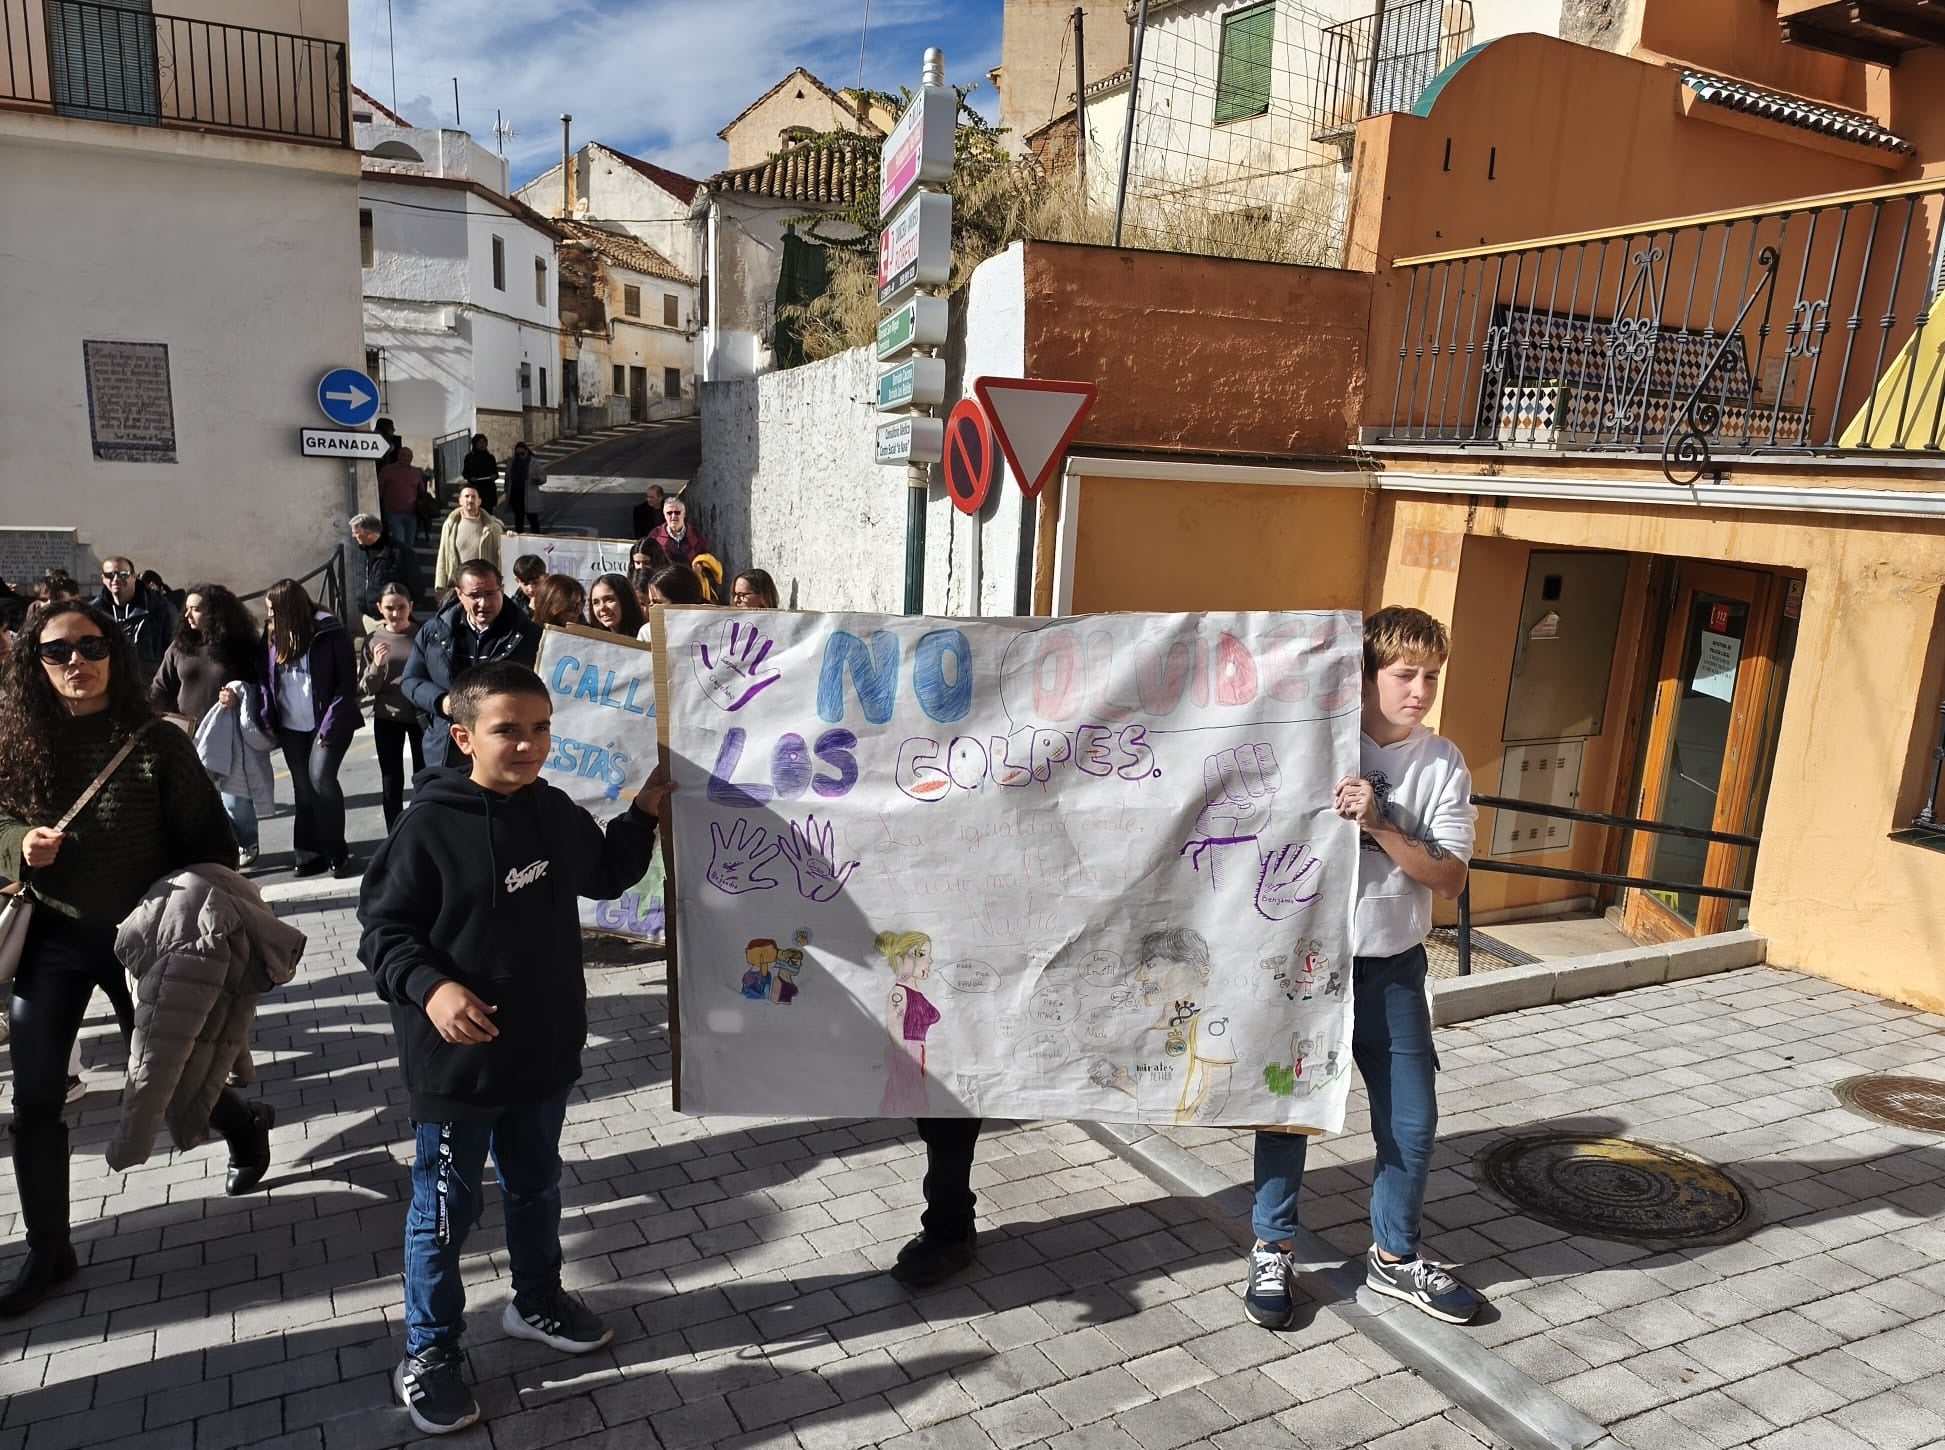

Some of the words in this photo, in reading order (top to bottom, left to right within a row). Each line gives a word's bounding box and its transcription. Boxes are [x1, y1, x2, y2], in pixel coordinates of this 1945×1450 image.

[305, 434, 380, 452] GRANADA
[1717, 611, 1727, 621] 112
[552, 655, 657, 718] CALL
[816, 628, 974, 725] NO
[706, 727, 859, 808] LOS
[864, 812, 926, 854] La
[597, 892, 665, 936] GU
[968, 893, 1060, 939] Nadie
